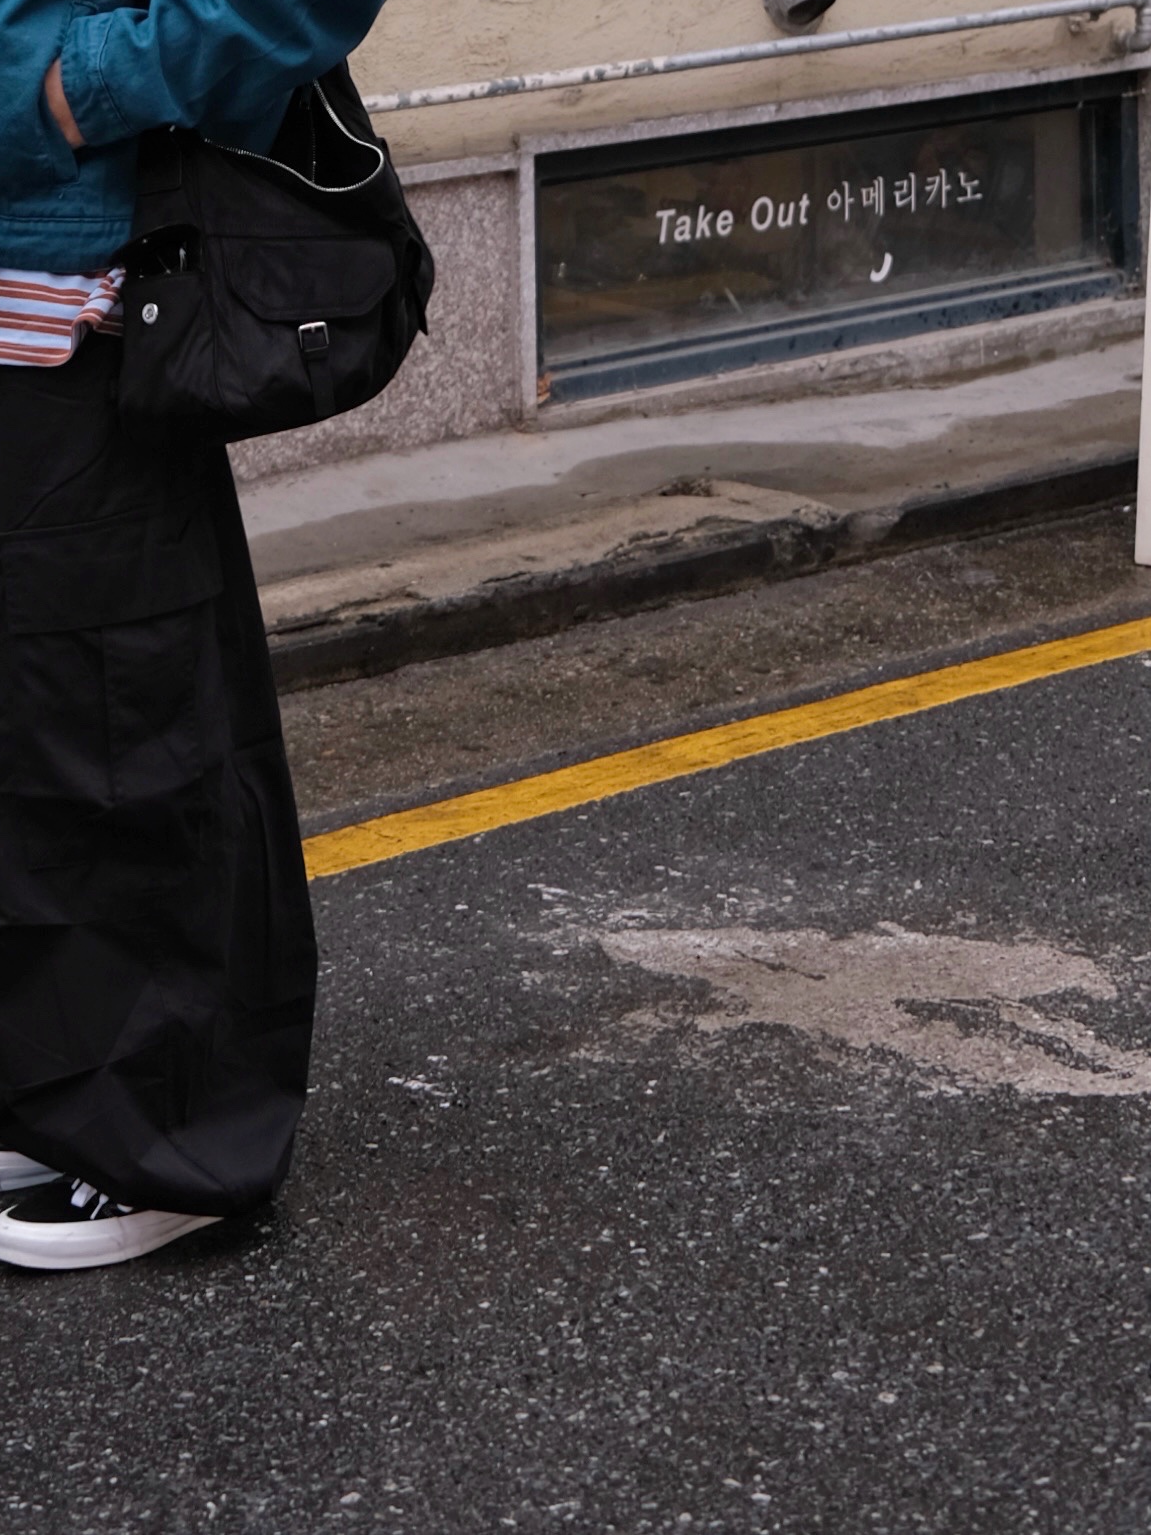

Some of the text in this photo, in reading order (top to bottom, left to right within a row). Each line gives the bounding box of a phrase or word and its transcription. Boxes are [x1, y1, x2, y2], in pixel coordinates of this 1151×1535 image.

[655, 169, 983, 245] Take Out 아메리카노
